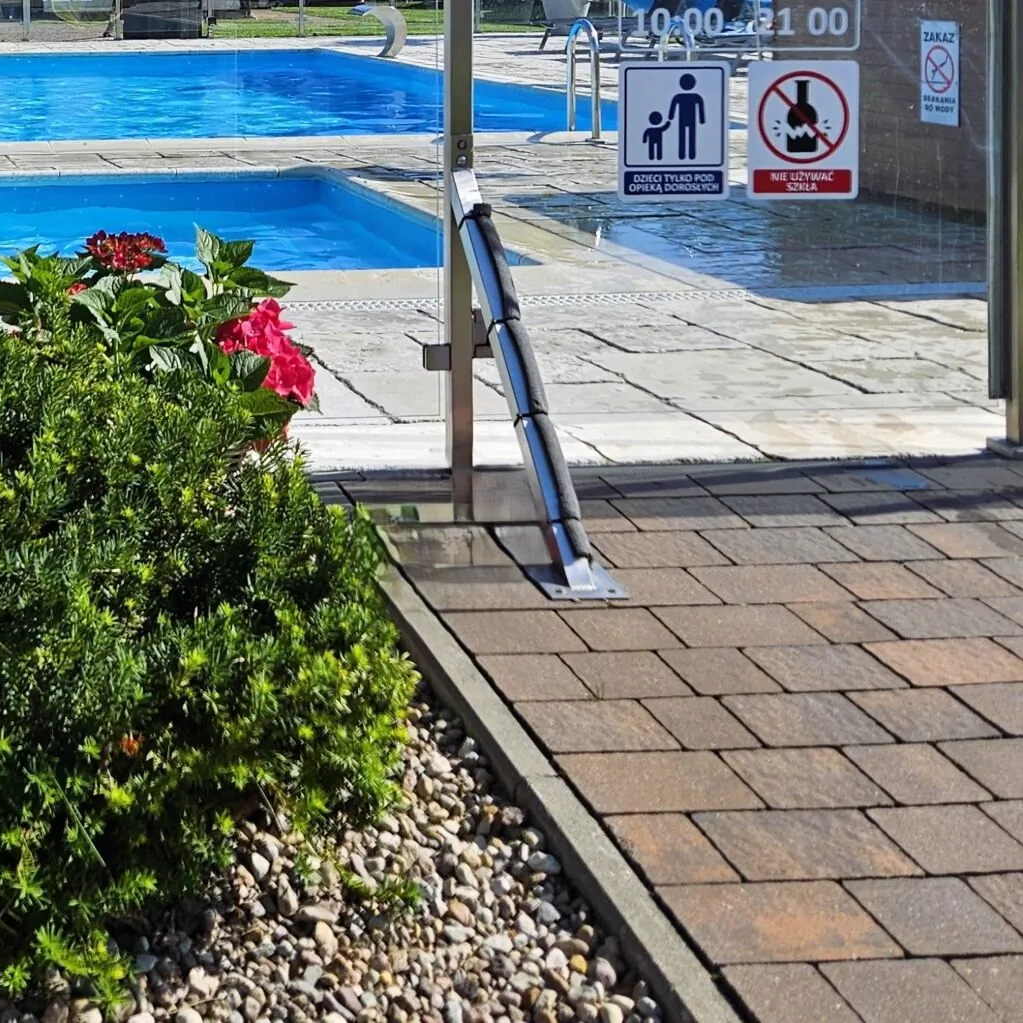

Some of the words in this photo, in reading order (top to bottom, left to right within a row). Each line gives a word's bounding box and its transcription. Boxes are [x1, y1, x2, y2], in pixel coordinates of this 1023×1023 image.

[923, 31, 955, 44] ZAKAZ
[633, 174, 662, 183] DZIECI
[663, 173, 693, 183] TYLKO
[694, 173, 715, 182] POD
[769, 171, 788, 182] NIE
[628, 183, 663, 193] OPIEKĄ
[664, 182, 720, 192] DOROSŁYCH
[785, 181, 818, 192] SZKŁA
